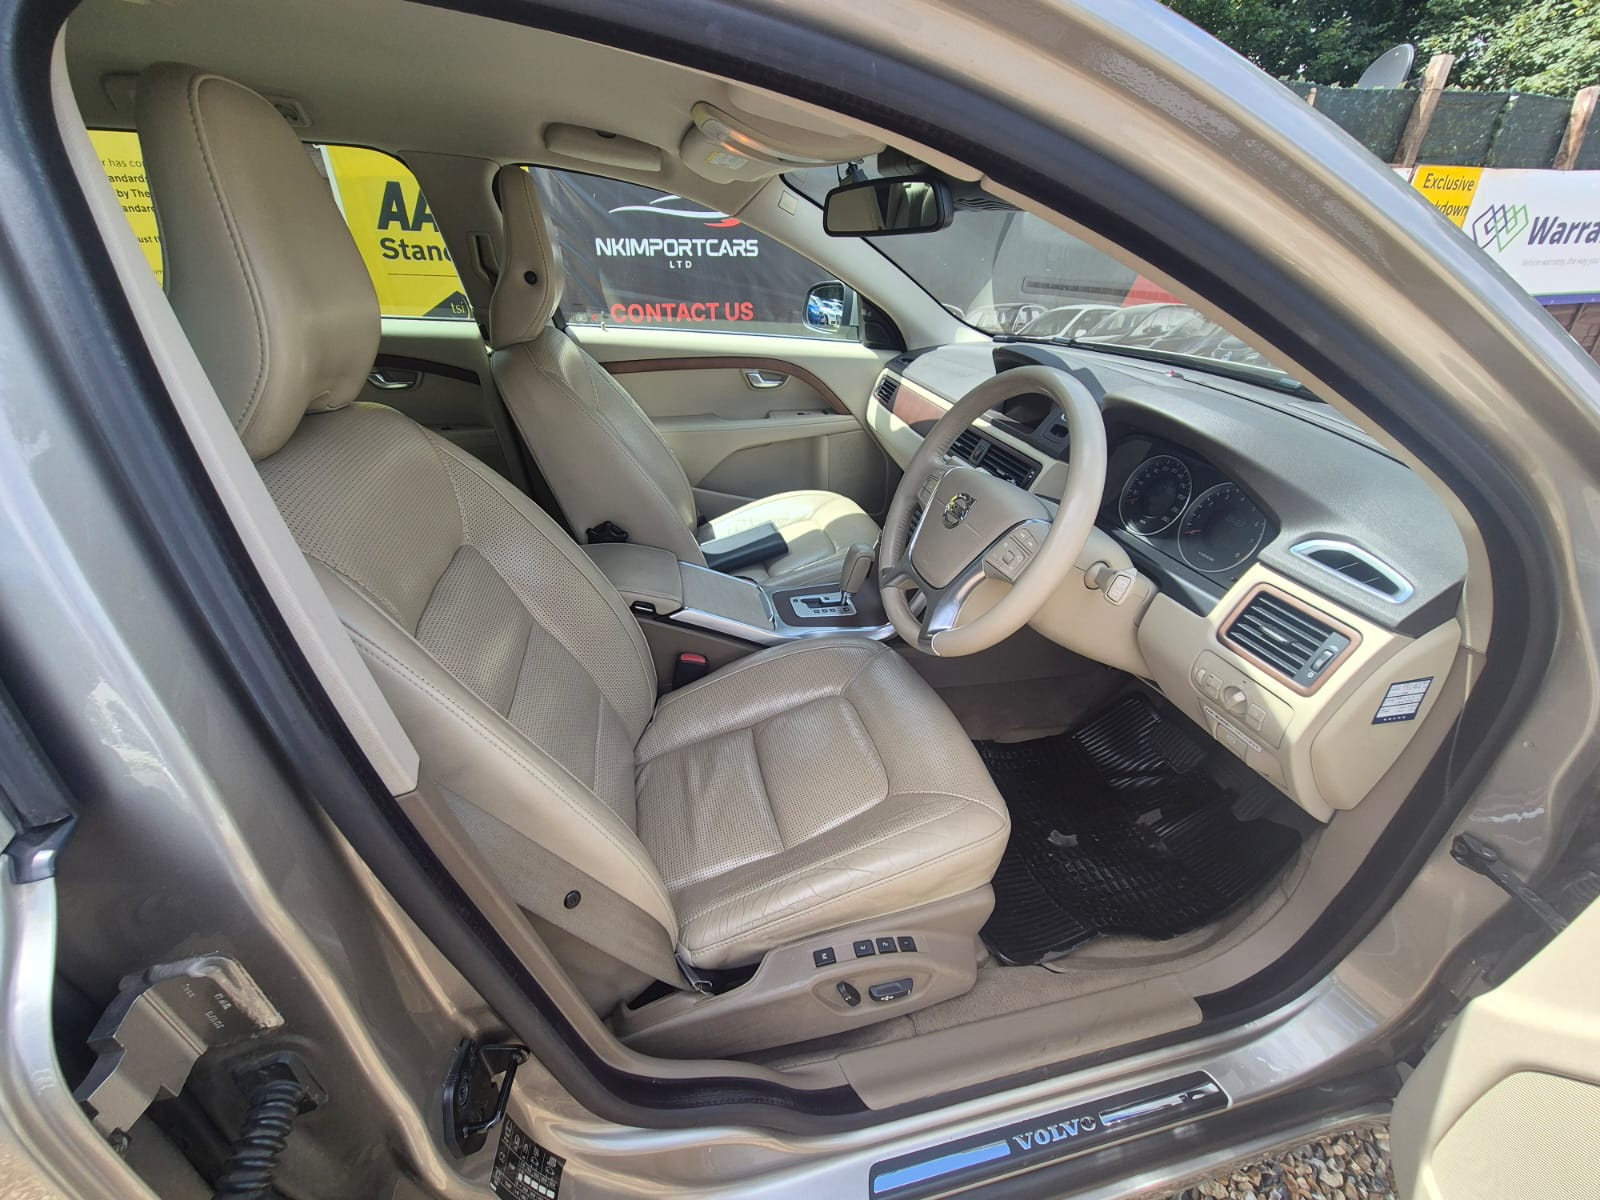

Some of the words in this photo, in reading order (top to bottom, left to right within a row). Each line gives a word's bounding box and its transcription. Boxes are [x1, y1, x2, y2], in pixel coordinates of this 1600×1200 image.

[108, 158, 127, 168] has
[129, 160, 144, 168] co
[108, 173, 147, 183] andard
[1423, 172, 1475, 191] Exclusive
[115, 189, 129, 200] by
[130, 189, 151, 198] The
[1527, 216, 1600, 246] Warra
[595, 238, 759, 257] NKIMPORTCARS
[669, 260, 693, 269] LTD
[450, 300, 465, 314] tsi
[610, 302, 720, 323] CONTACT
[725, 302, 754, 321] US
[1012, 1116, 1097, 1151] VOLVO
